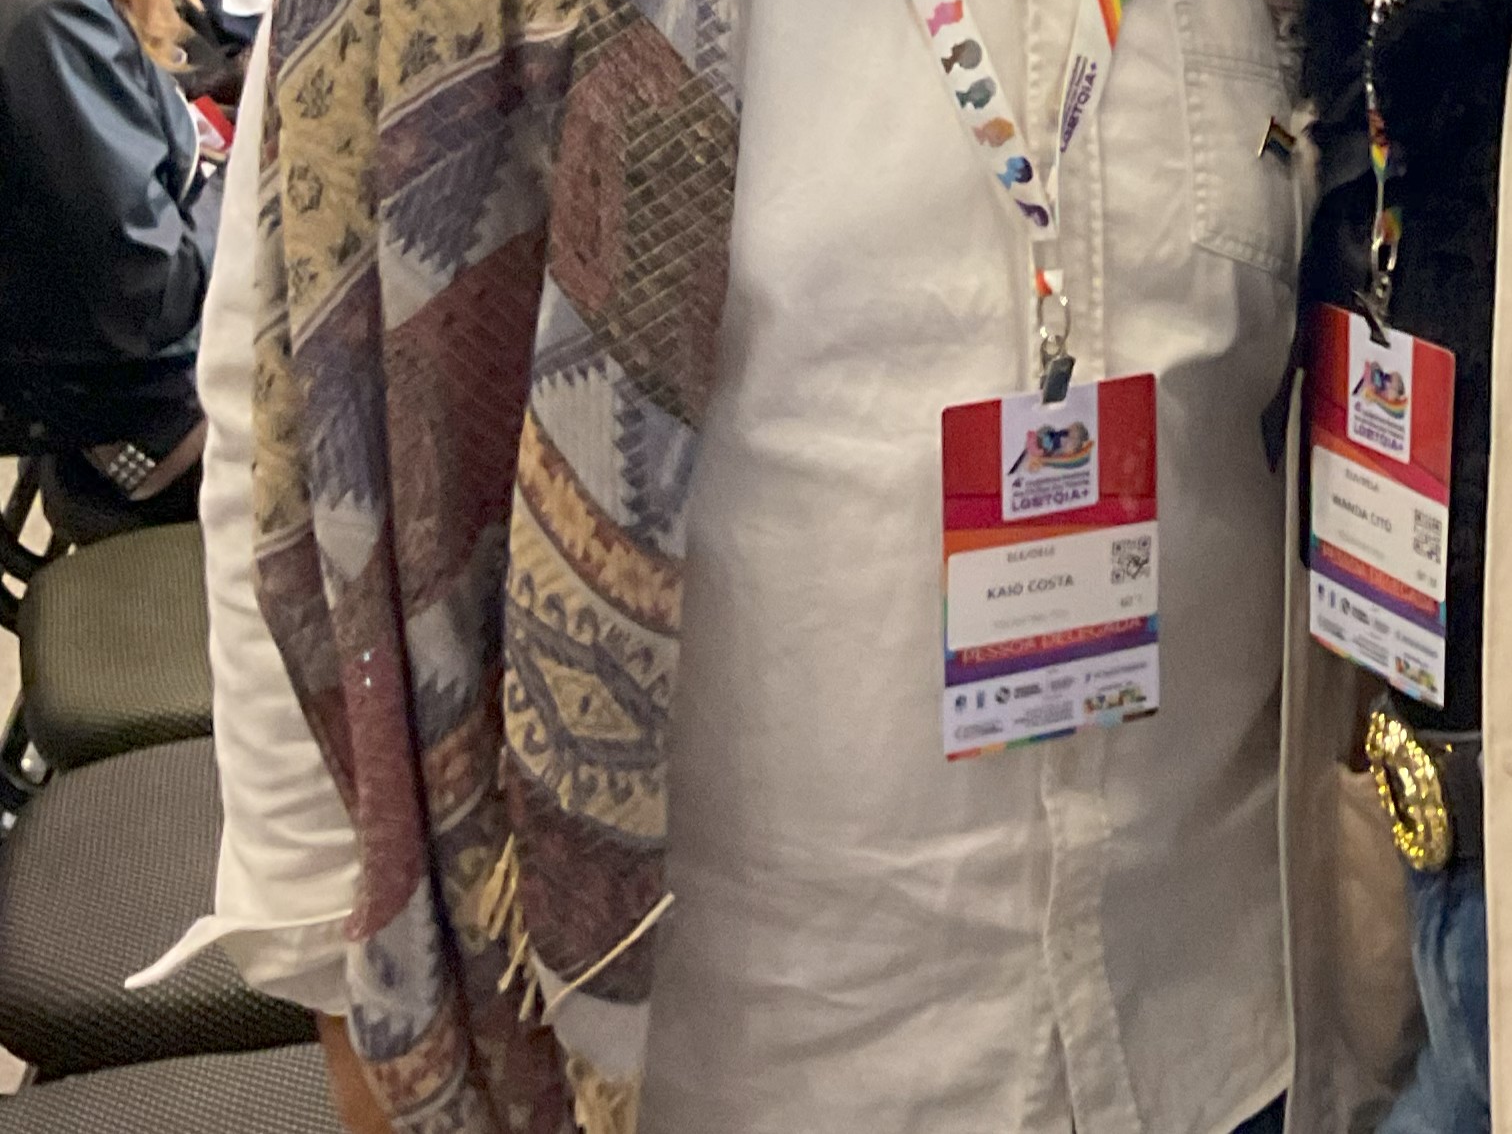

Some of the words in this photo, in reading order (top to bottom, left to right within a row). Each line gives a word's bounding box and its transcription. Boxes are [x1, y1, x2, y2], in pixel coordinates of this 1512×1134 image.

[1012, 488, 1089, 512] LGBTQIA+
[987, 582, 1024, 601] KAIO
[1027, 574, 1074, 593] COSTA
